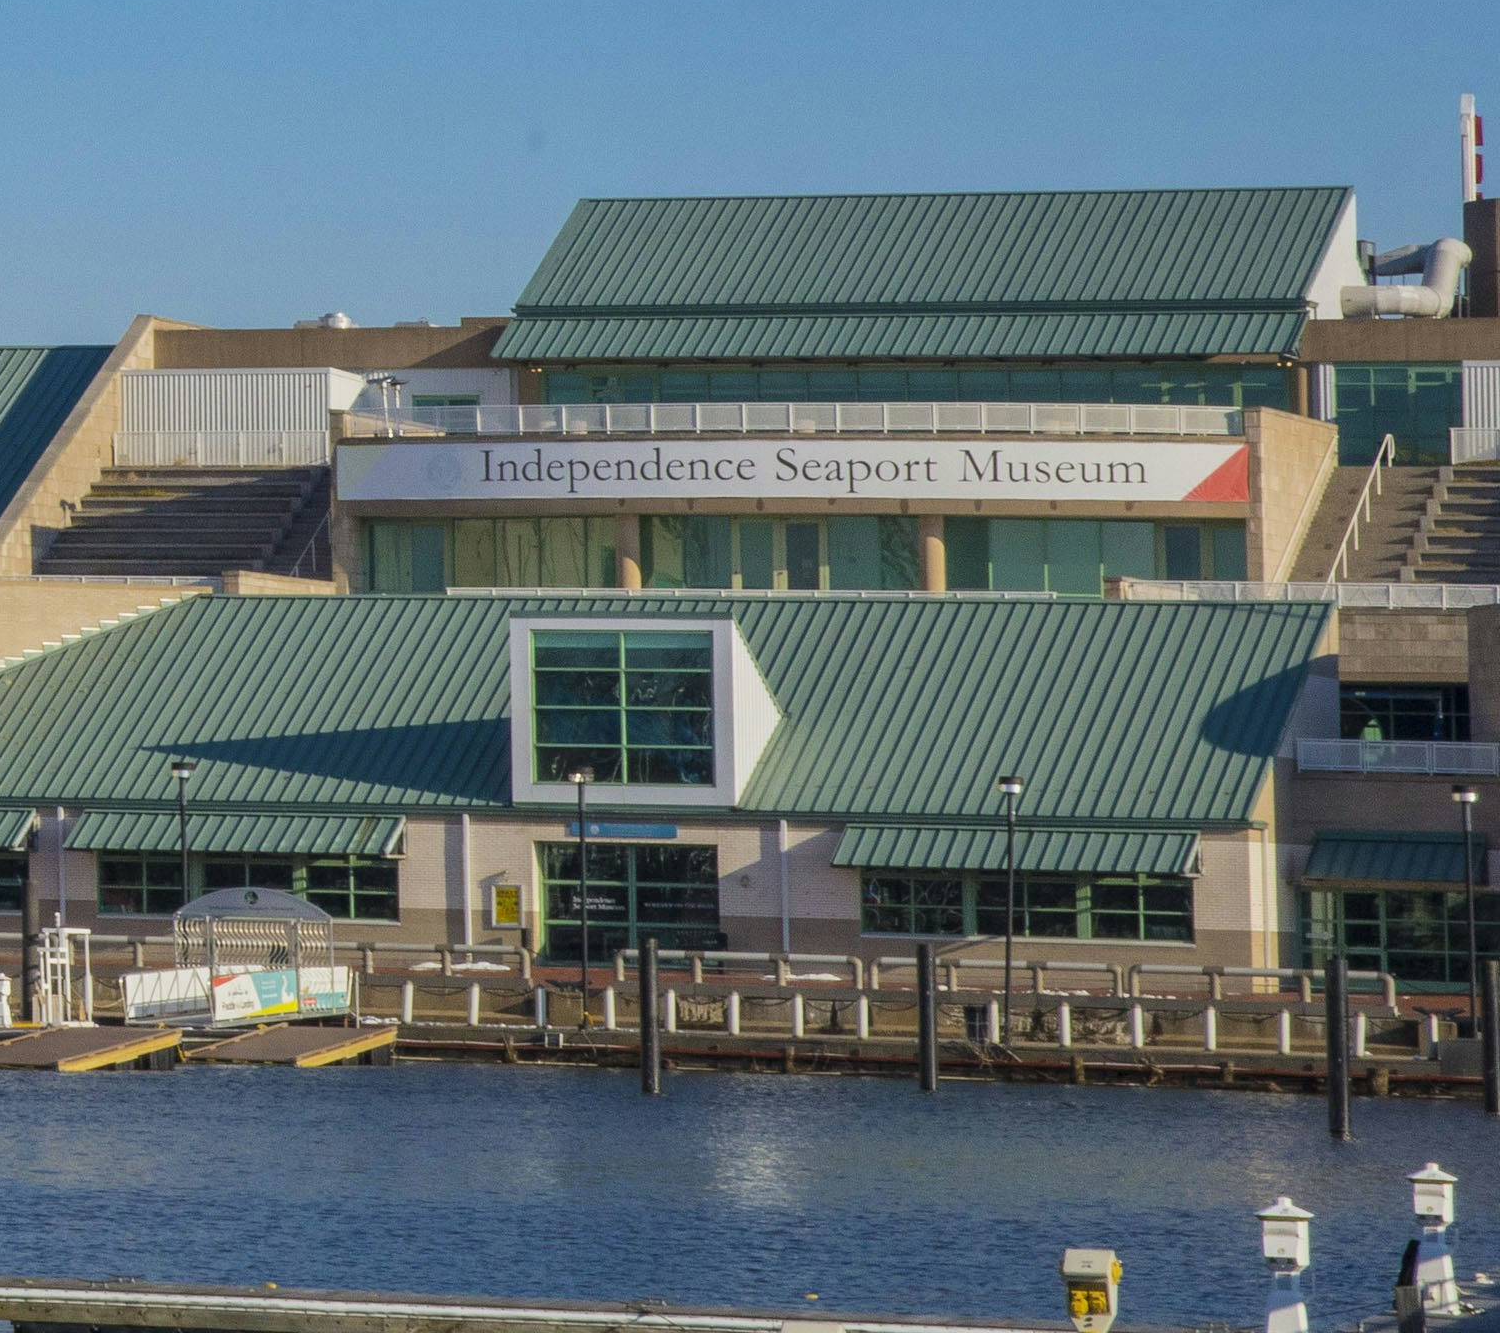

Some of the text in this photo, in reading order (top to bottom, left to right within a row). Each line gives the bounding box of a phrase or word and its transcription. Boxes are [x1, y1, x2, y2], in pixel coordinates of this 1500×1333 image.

[480, 447, 1149, 494] Independence Seaport Museum
